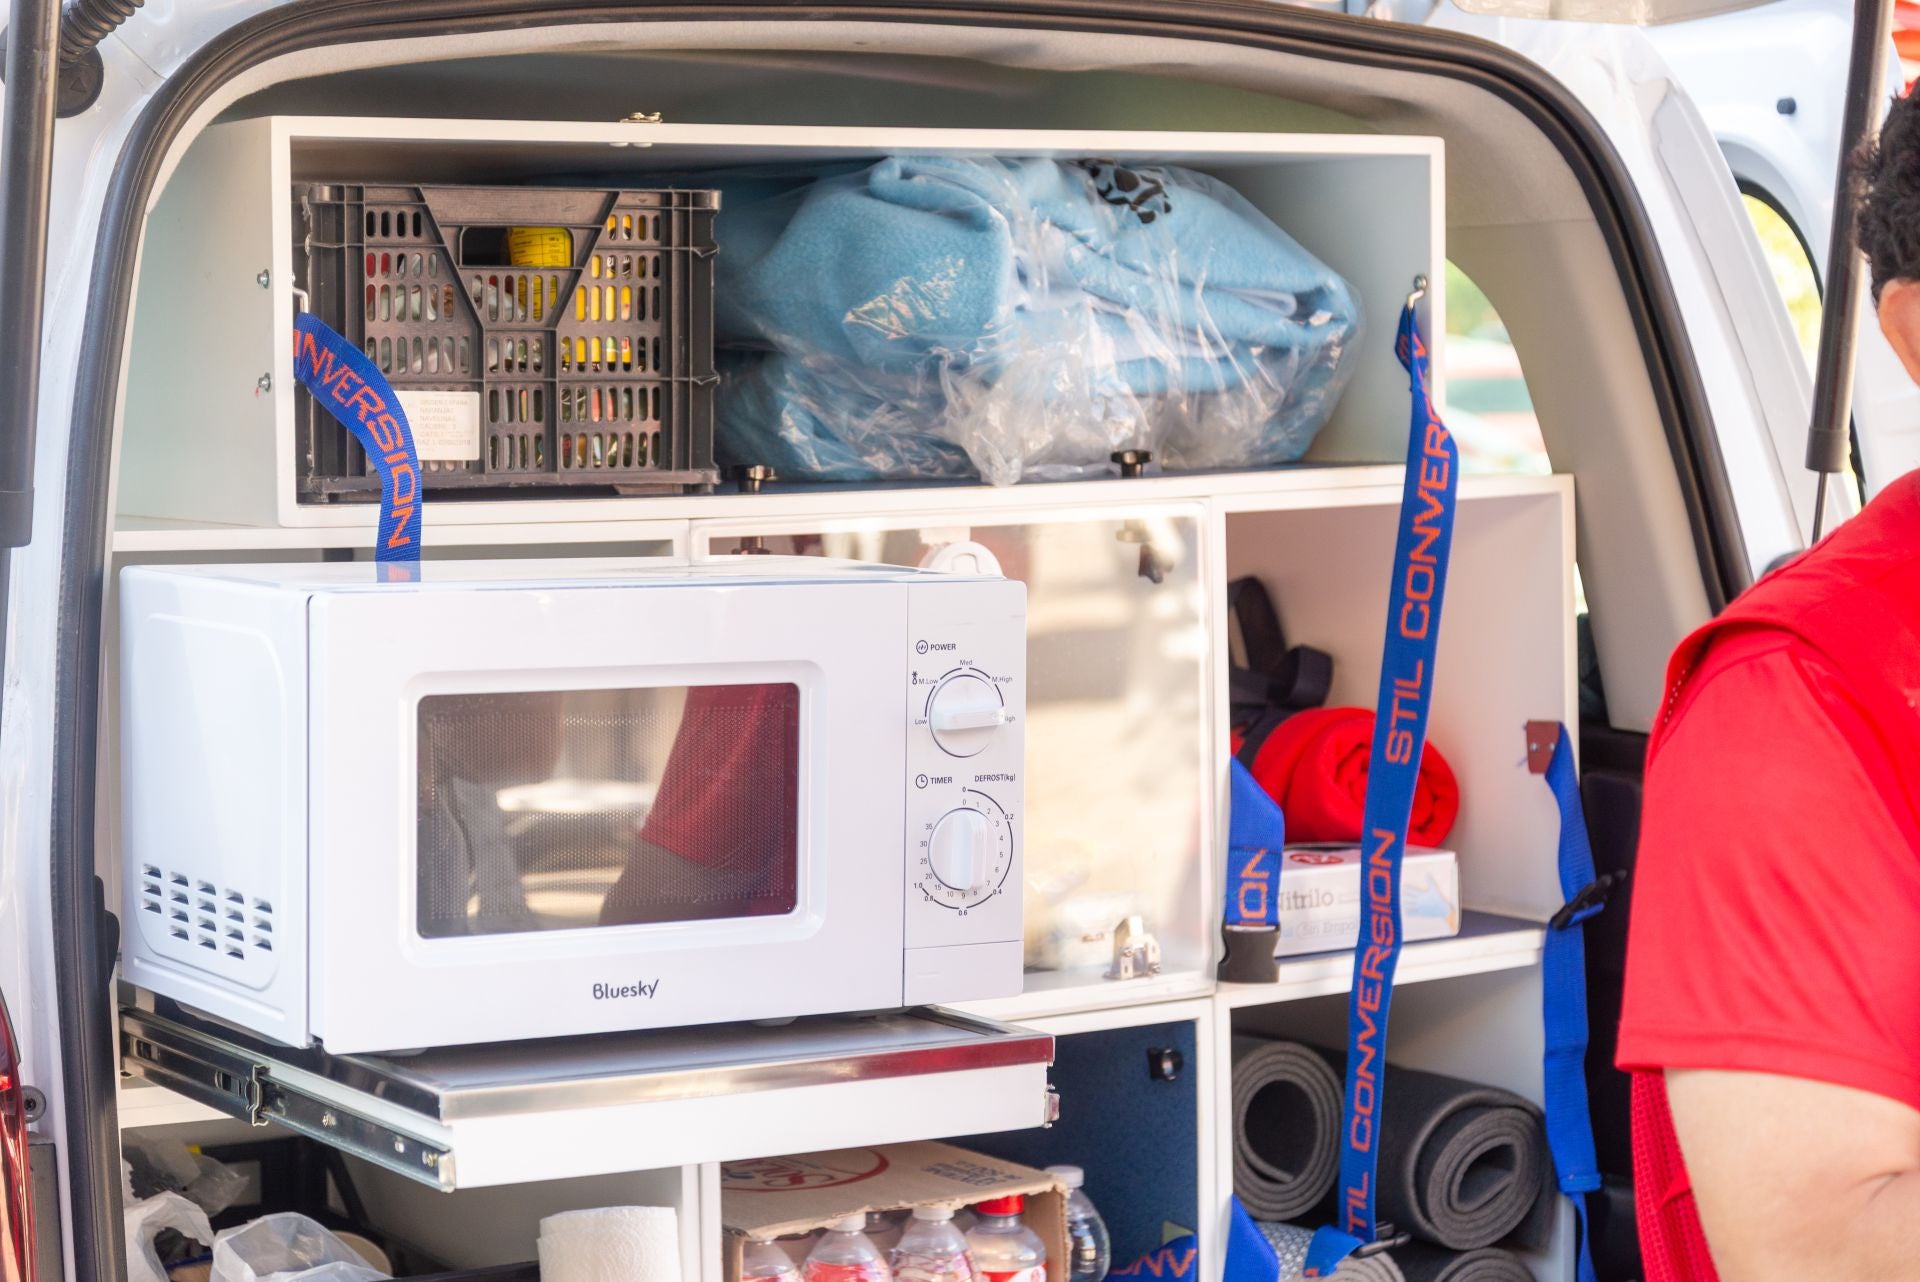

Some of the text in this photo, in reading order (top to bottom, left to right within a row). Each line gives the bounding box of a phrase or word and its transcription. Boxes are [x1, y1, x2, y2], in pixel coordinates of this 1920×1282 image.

[930, 643, 957, 651] POWER
[918, 678, 939, 686] M.Low
[991, 676, 1013, 684] M.High
[1385, 659, 1424, 765] STIL
[1004, 715, 1016, 723] igh
[931, 776, 953, 785] TIMER
[592, 978, 660, 1000] Bluesky
[1350, 829, 1396, 1152] CONVERSION
[1347, 1171, 1369, 1241] TIL
